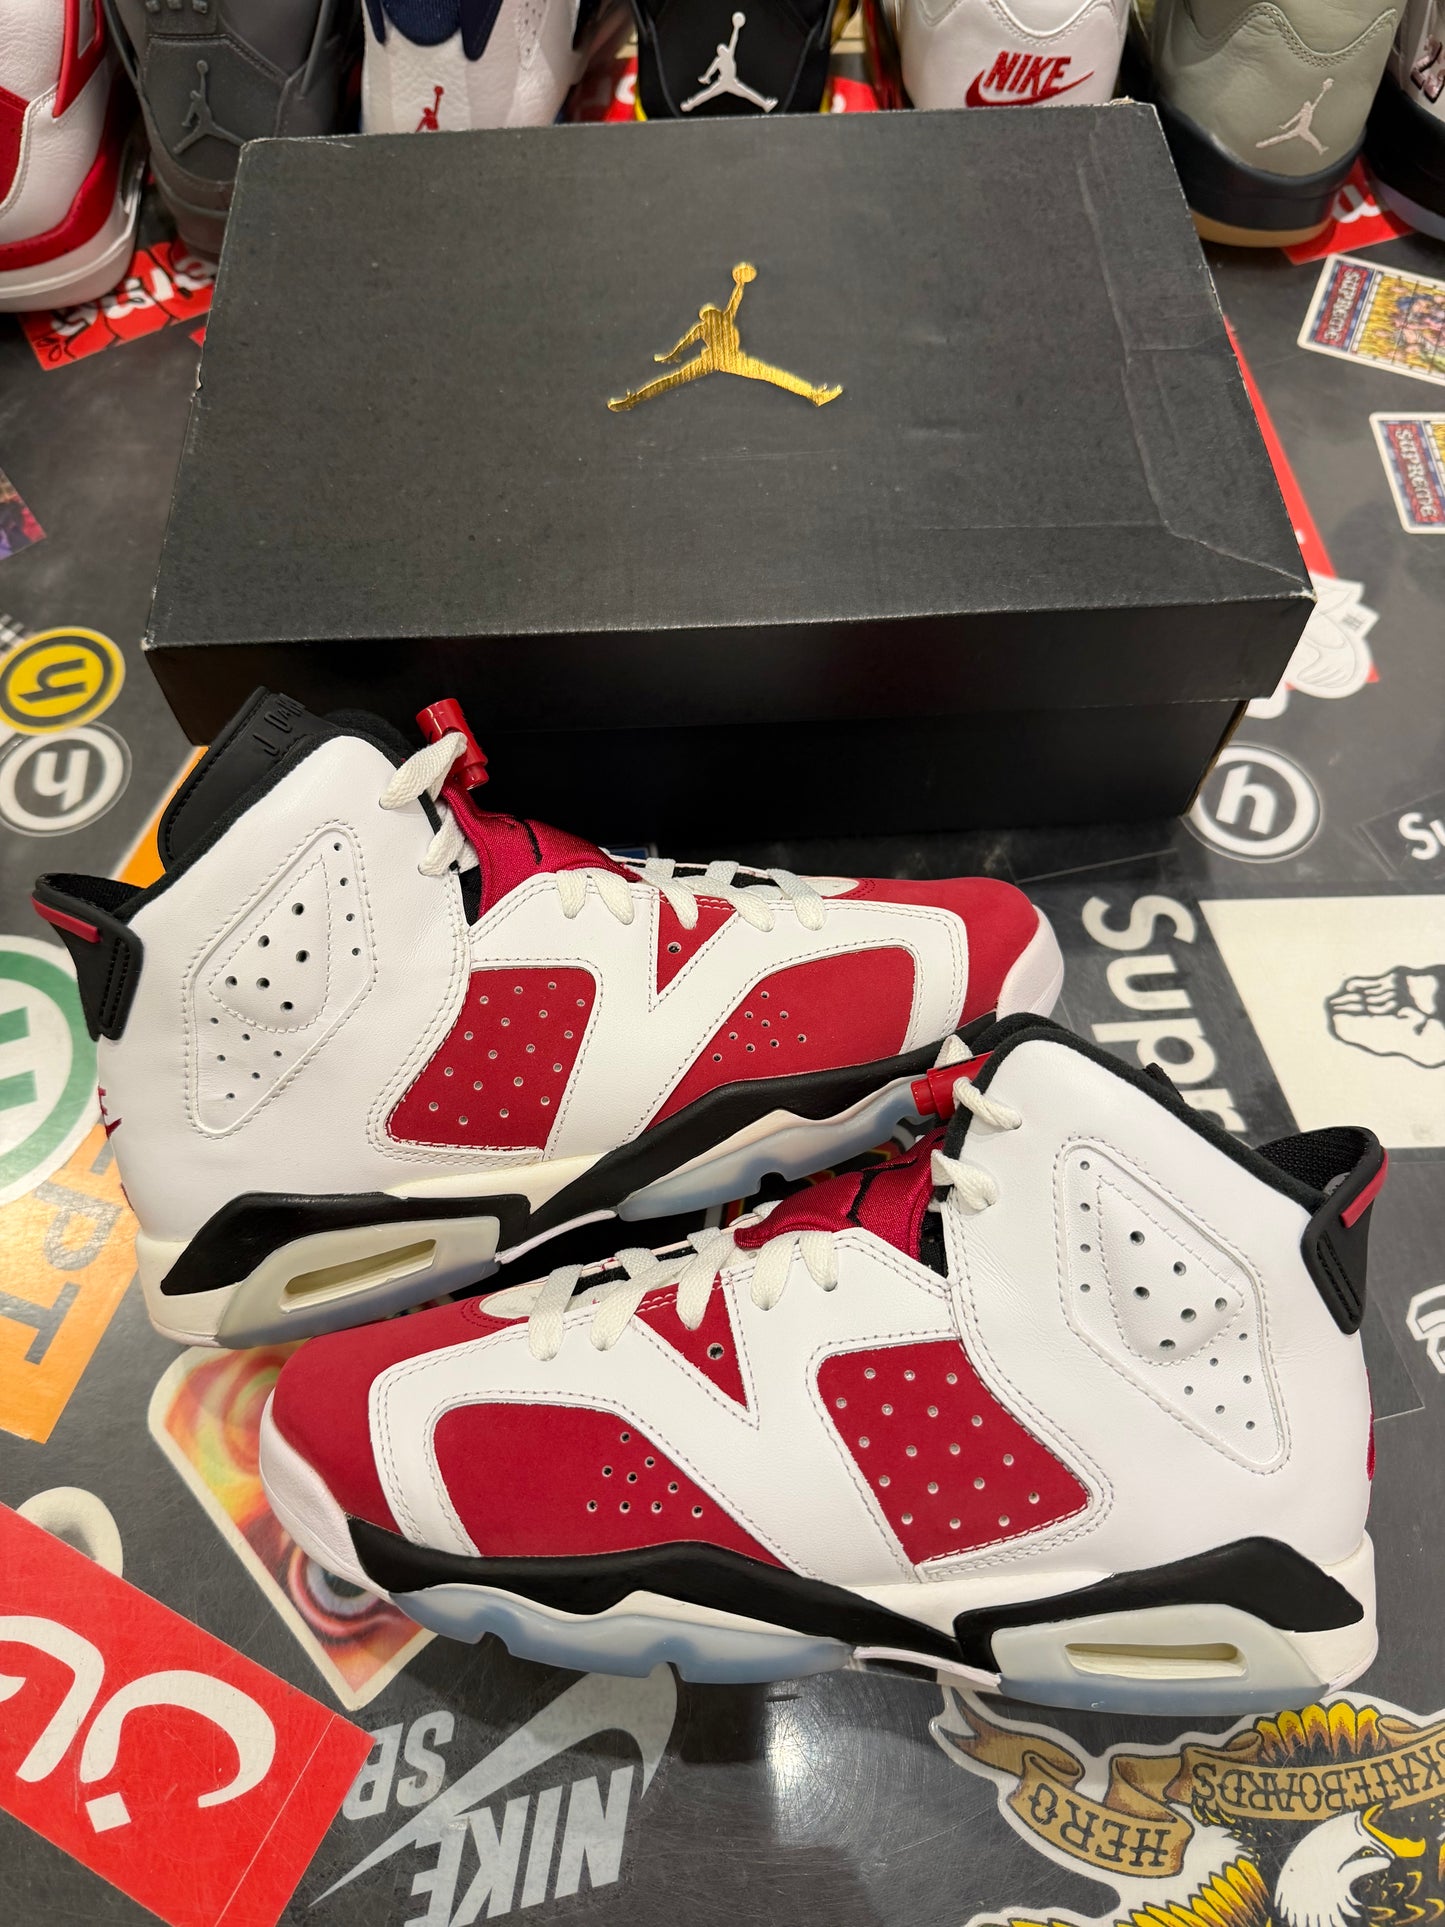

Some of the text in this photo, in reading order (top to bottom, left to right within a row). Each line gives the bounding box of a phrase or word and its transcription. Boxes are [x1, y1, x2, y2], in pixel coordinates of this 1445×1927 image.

[983, 50, 1072, 98] NIKE
[1216, 765, 1277, 834] h
[343, 1710, 456, 1821] SB
[1192, 1739, 1445, 1813] KATEBOARDS
[404, 1765, 636, 1927] NIKE
[1029, 1783, 1170, 1868] HERO
